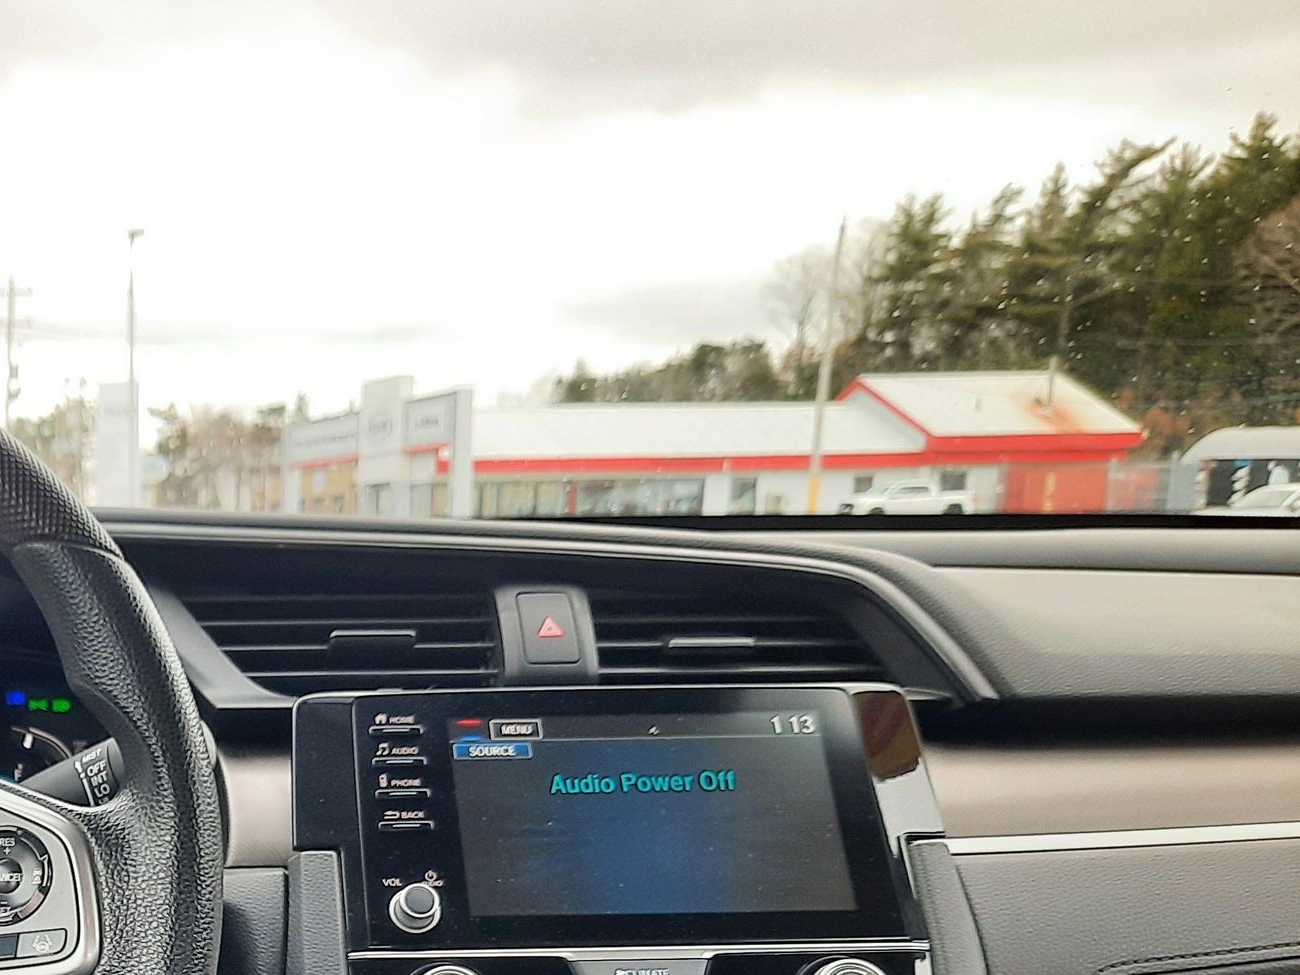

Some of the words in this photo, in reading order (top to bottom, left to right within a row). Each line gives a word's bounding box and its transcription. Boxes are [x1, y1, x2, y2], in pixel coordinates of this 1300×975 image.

[389, 715, 415, 724] HOME
[501, 725, 533, 735] MENU
[391, 746, 419, 755] AUDIO
[469, 746, 517, 757] SOURCE
[87, 759, 106, 777] OFF
[90, 772, 108, 786] INT
[391, 778, 421, 787] PHONE
[550, 772, 615, 794] Audio
[620, 771, 694, 793] Power
[699, 769, 736, 791] Off
[94, 783, 110, 797] LO
[401, 811, 425, 819] BACK
[0, 838, 15, 847] RES
[382, 878, 402, 887] VOL
